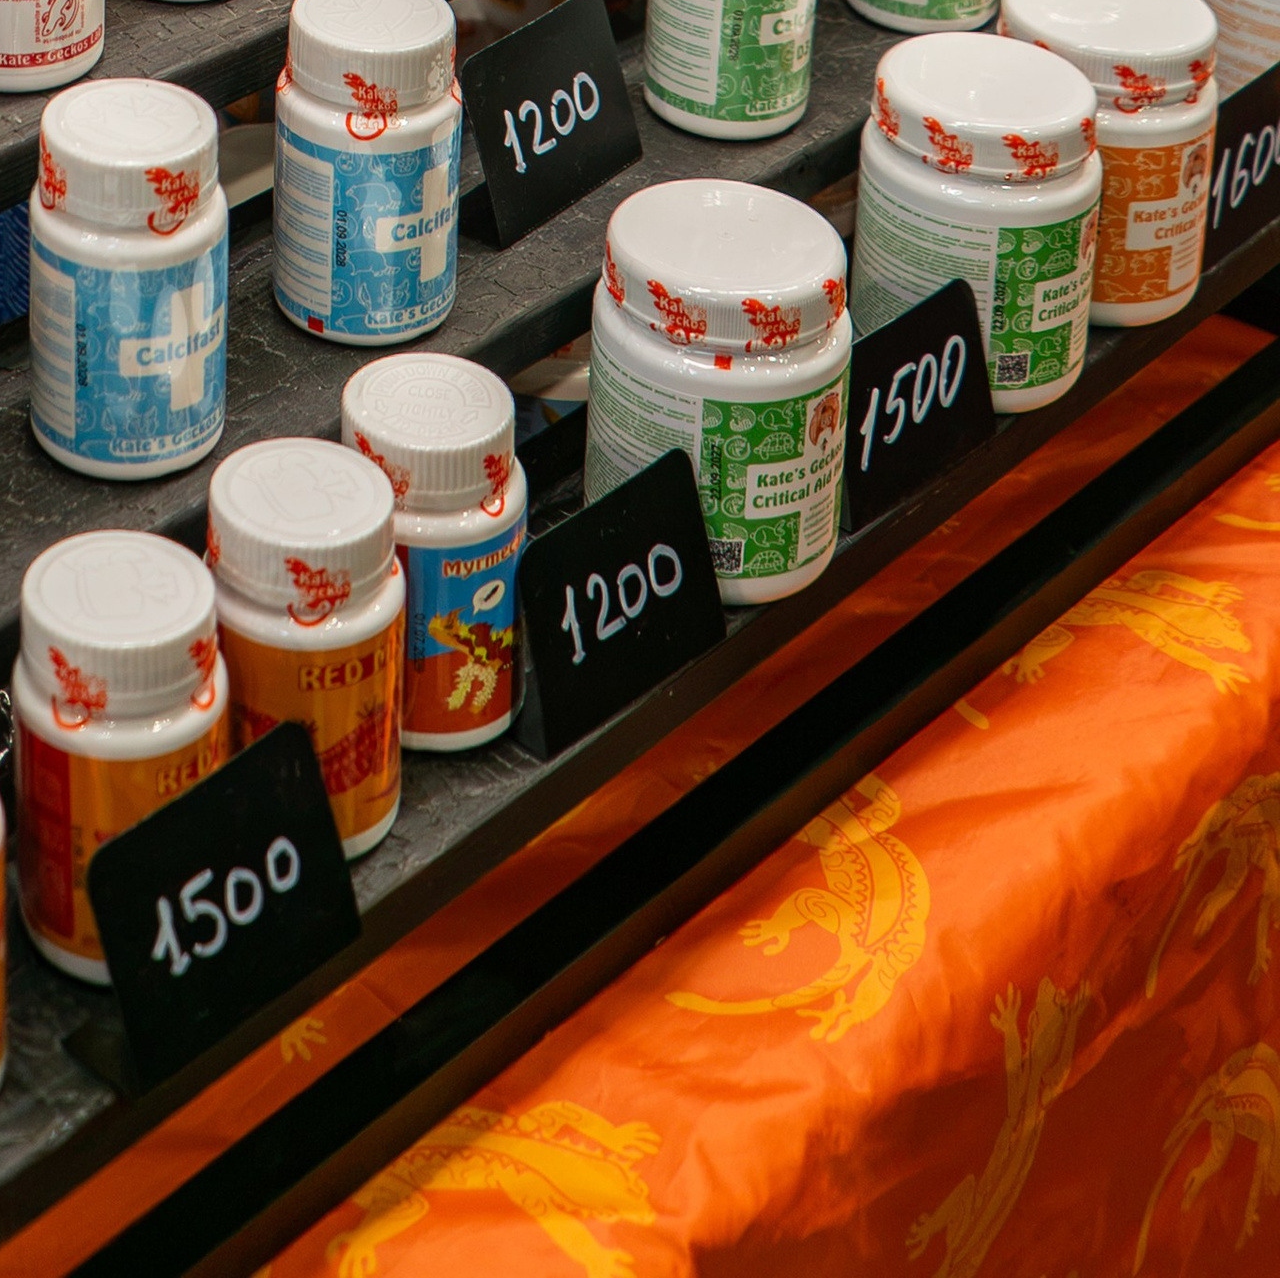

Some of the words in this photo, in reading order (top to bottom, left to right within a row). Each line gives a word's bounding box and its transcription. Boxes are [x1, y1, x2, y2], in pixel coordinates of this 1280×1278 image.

[47, 39, 89, 61] Geckos
[357, 86, 398, 100] Kate's
[358, 99, 399, 111] Geckos
[504, 71, 600, 174] 1200
[1133, 204, 1179, 224] Kate's
[336, 209, 348, 268] 01.09.2028
[1154, 217, 1197, 241] Critical
[1042, 279, 1078, 304] Kate's
[366, 307, 417, 327] Kate's
[659, 296, 707, 318] Kate's
[756, 307, 801, 325] Kate's
[994, 278, 1007, 332] 22.09.2027
[1038, 297, 1081, 323] Critical
[659, 312, 707, 332] Geckos
[756, 318, 801, 334] Geckos
[136, 321, 222, 368] Calcifast
[405, 364, 447, 379] DOWN
[408, 385, 451, 401] CLOSE
[860, 335, 967, 472] 1500
[398, 401, 456, 421] TIGHTLY
[170, 415, 218, 444] Geckos
[757, 466, 806, 489] Kate's
[752, 485, 810, 511] Critical
[814, 471, 833, 495] Aid
[441, 531, 526, 579] Myrmec
[561, 544, 683, 665] 1200
[300, 658, 364, 692] RED
[152, 836, 301, 976] 1500
